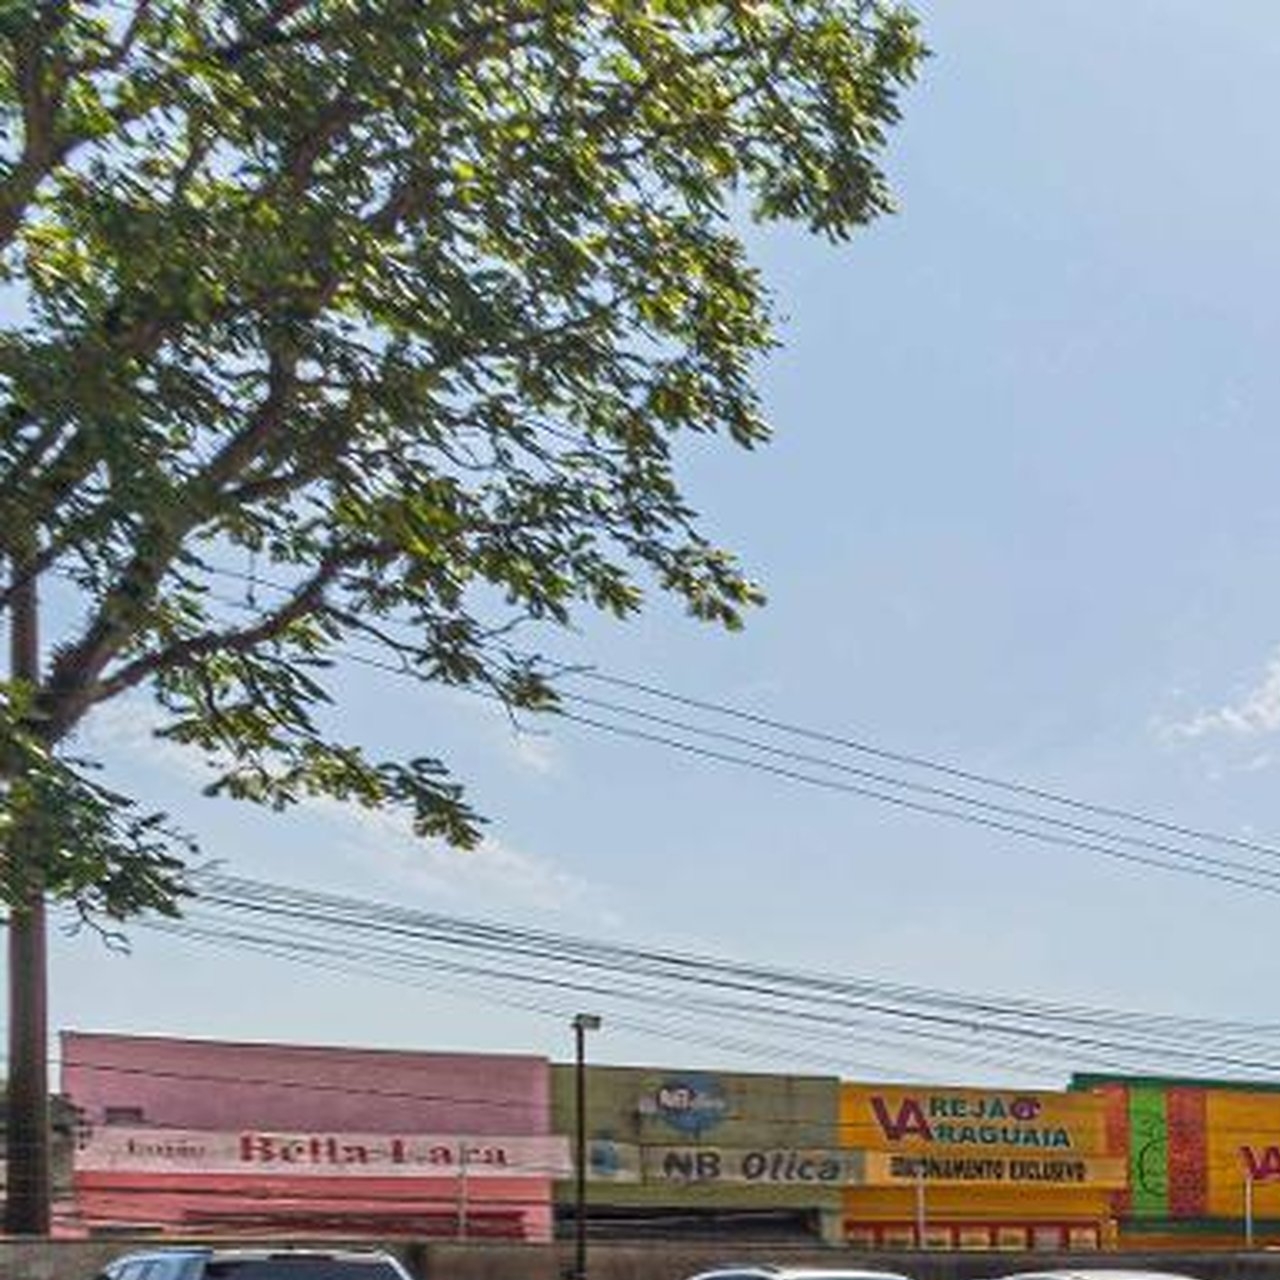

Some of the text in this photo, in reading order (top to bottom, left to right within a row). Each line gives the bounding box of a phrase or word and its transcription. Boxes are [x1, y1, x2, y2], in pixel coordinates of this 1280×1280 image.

[239, 1132, 368, 1164] Bella
[390, 1138, 508, 1168] Lara
[662, 1152, 721, 1179] NB
